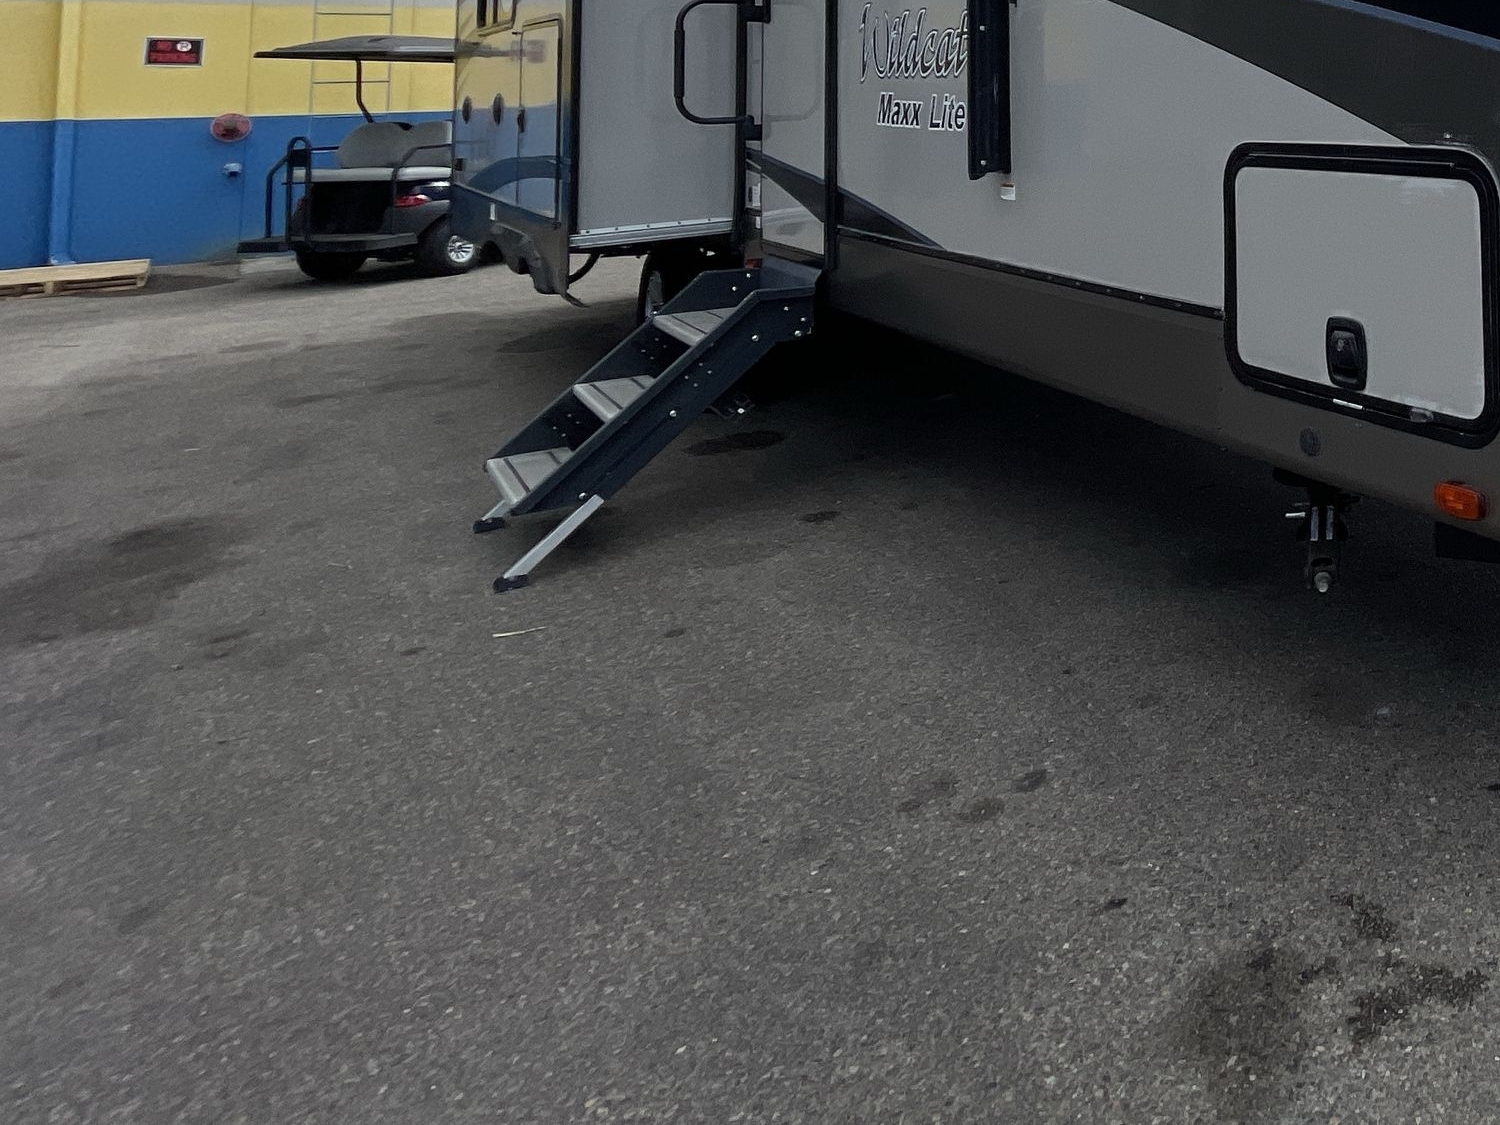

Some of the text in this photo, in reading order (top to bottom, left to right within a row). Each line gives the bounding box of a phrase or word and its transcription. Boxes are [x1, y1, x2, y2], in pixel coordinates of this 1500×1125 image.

[858, 2, 968, 84] Wildcat
[877, 91, 968, 132] Maxx Lite
